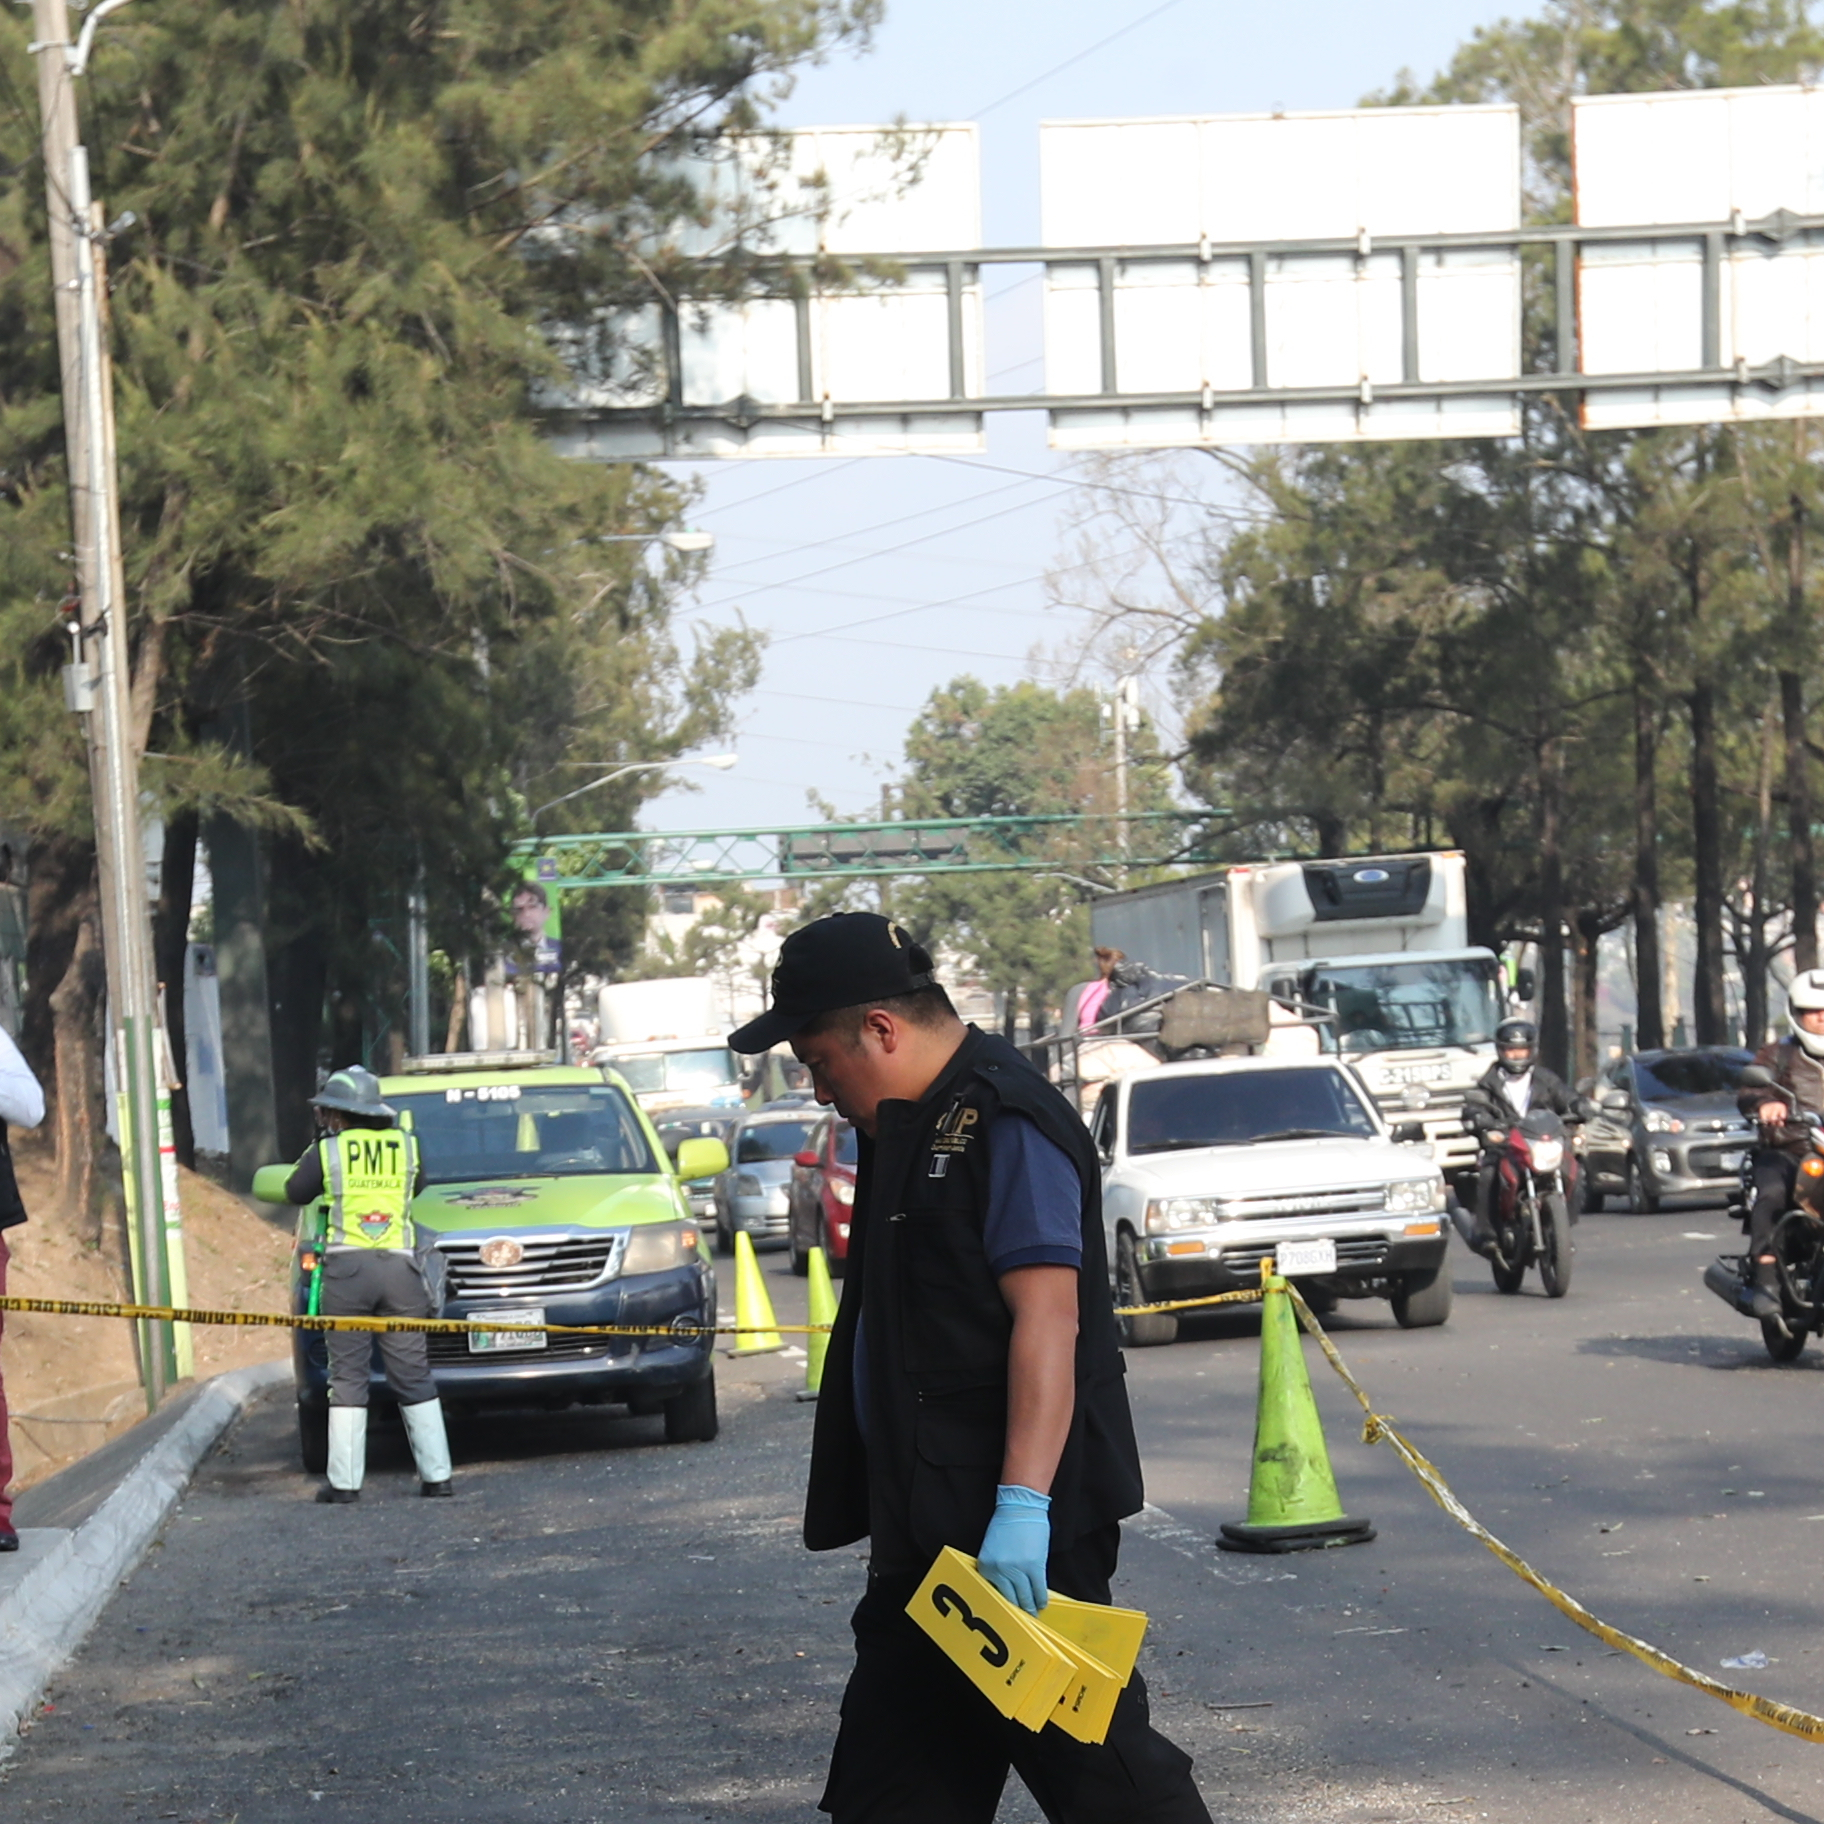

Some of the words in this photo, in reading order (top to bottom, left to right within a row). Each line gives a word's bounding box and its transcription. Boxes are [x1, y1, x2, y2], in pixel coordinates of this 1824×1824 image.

[347, 1140, 400, 1175] PMT
[348, 1178, 400, 1189] GUATEMALA
[932, 1583, 1009, 1668] 3
